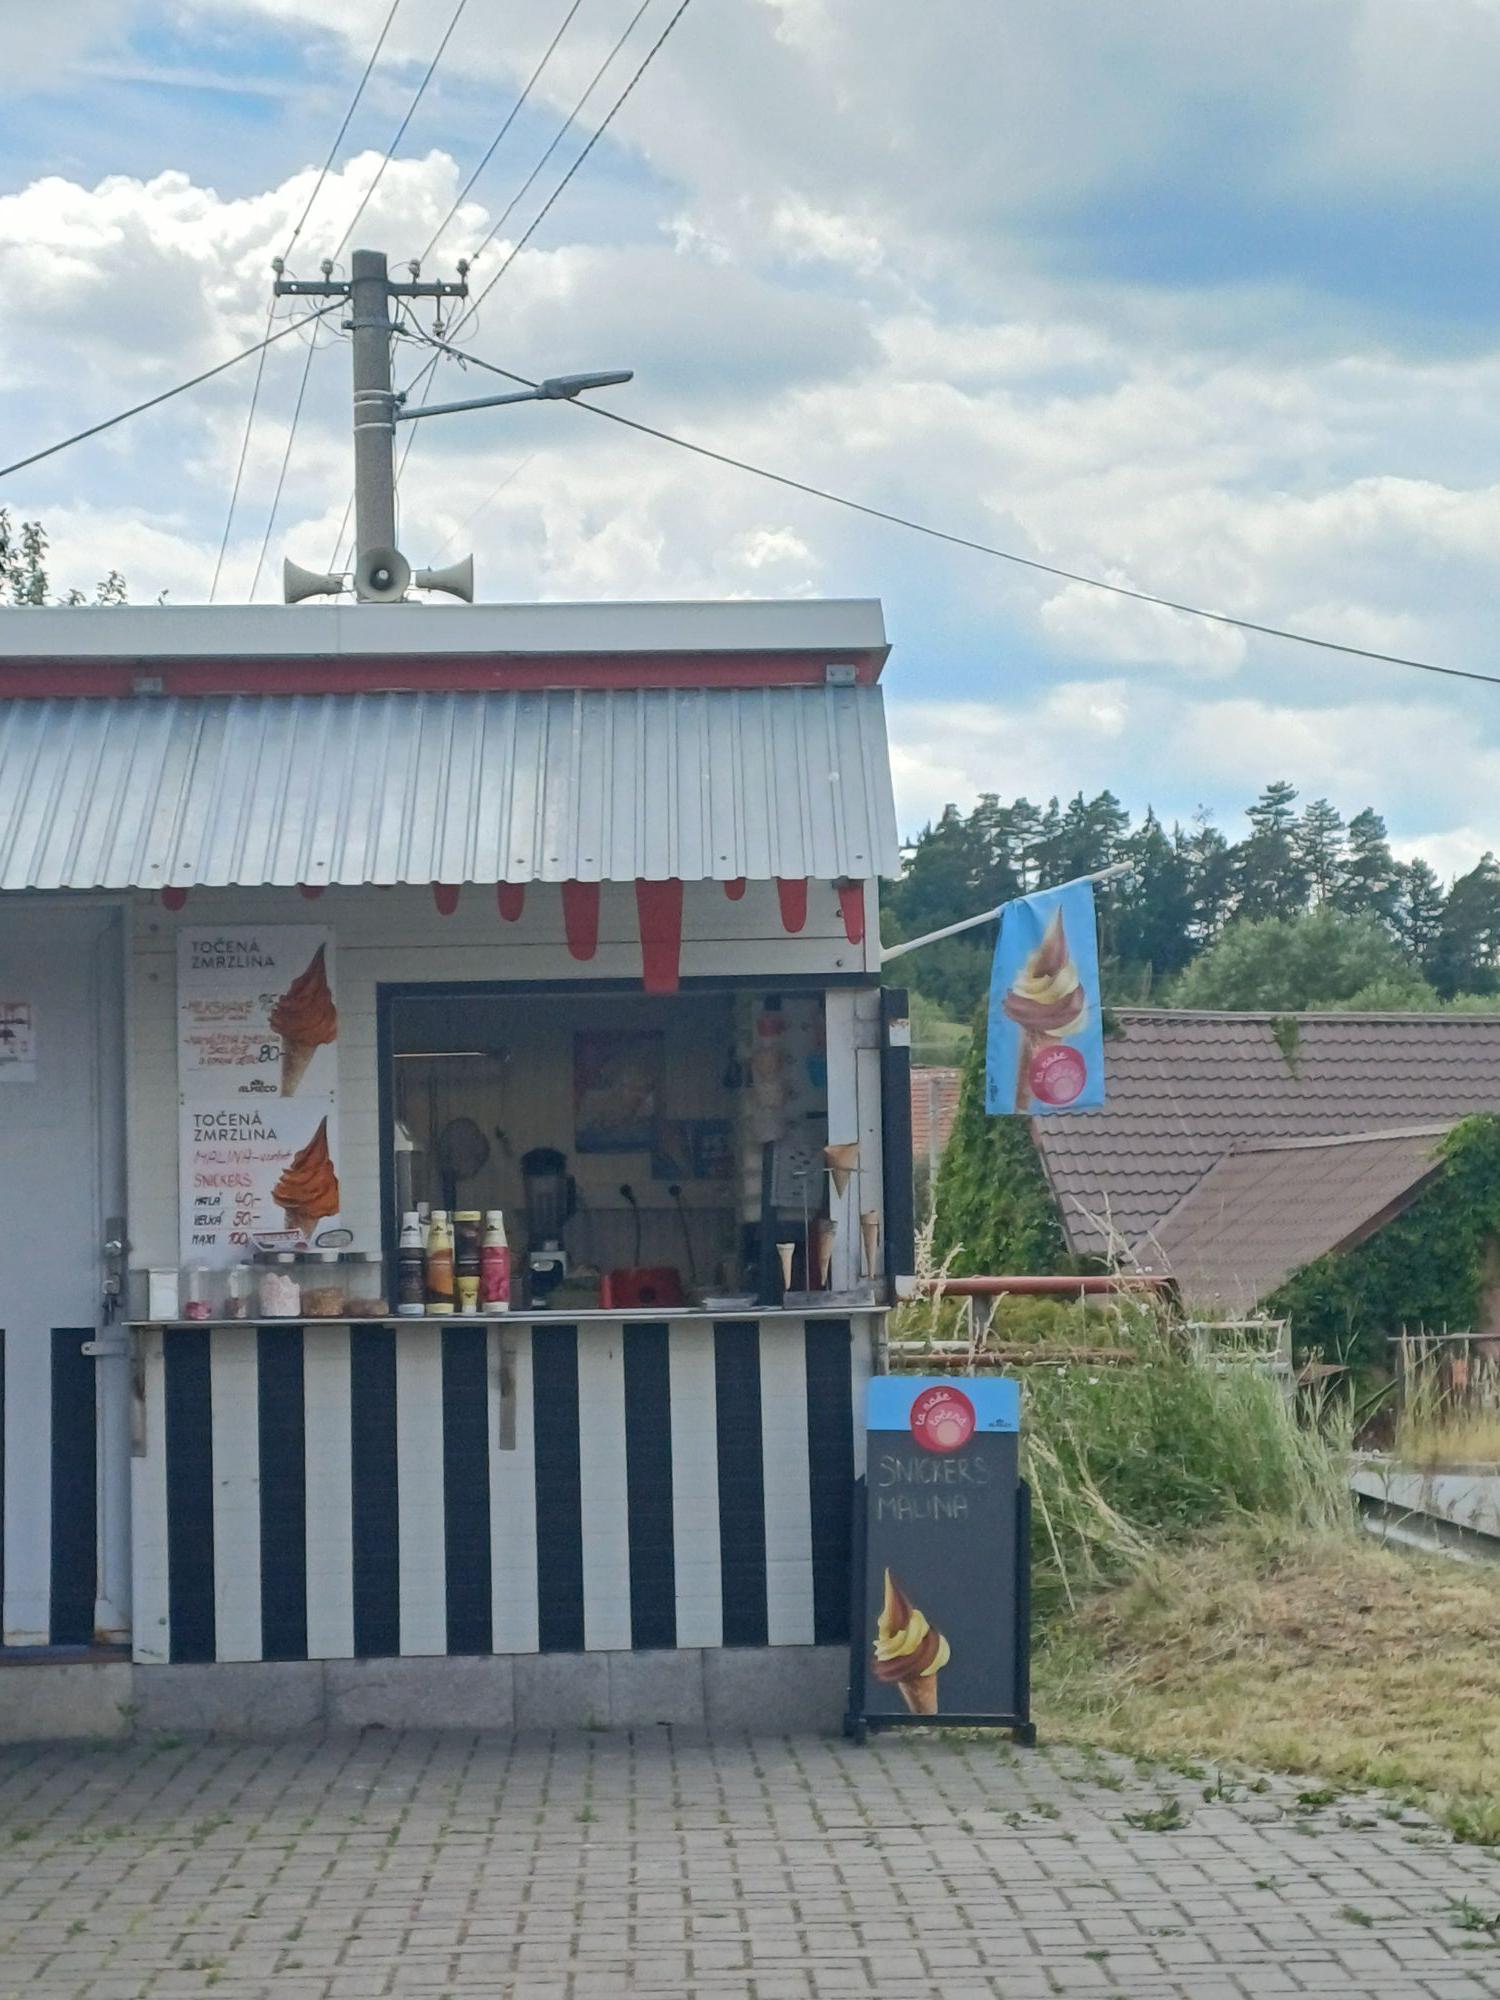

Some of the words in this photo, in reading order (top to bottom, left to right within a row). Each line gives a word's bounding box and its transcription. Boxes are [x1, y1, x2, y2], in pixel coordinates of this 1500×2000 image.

[192, 937, 260, 954] TOČENÁ
[192, 955, 276, 969] ZMRZLINA
[194, 1110, 262, 1127] TOČENÁ
[194, 1128, 277, 1142] ZMRZLINA
[193, 1172, 253, 1188] SNICKERS
[879, 1455, 988, 1487] SNICKERS
[877, 1494, 968, 1520] MALINA
